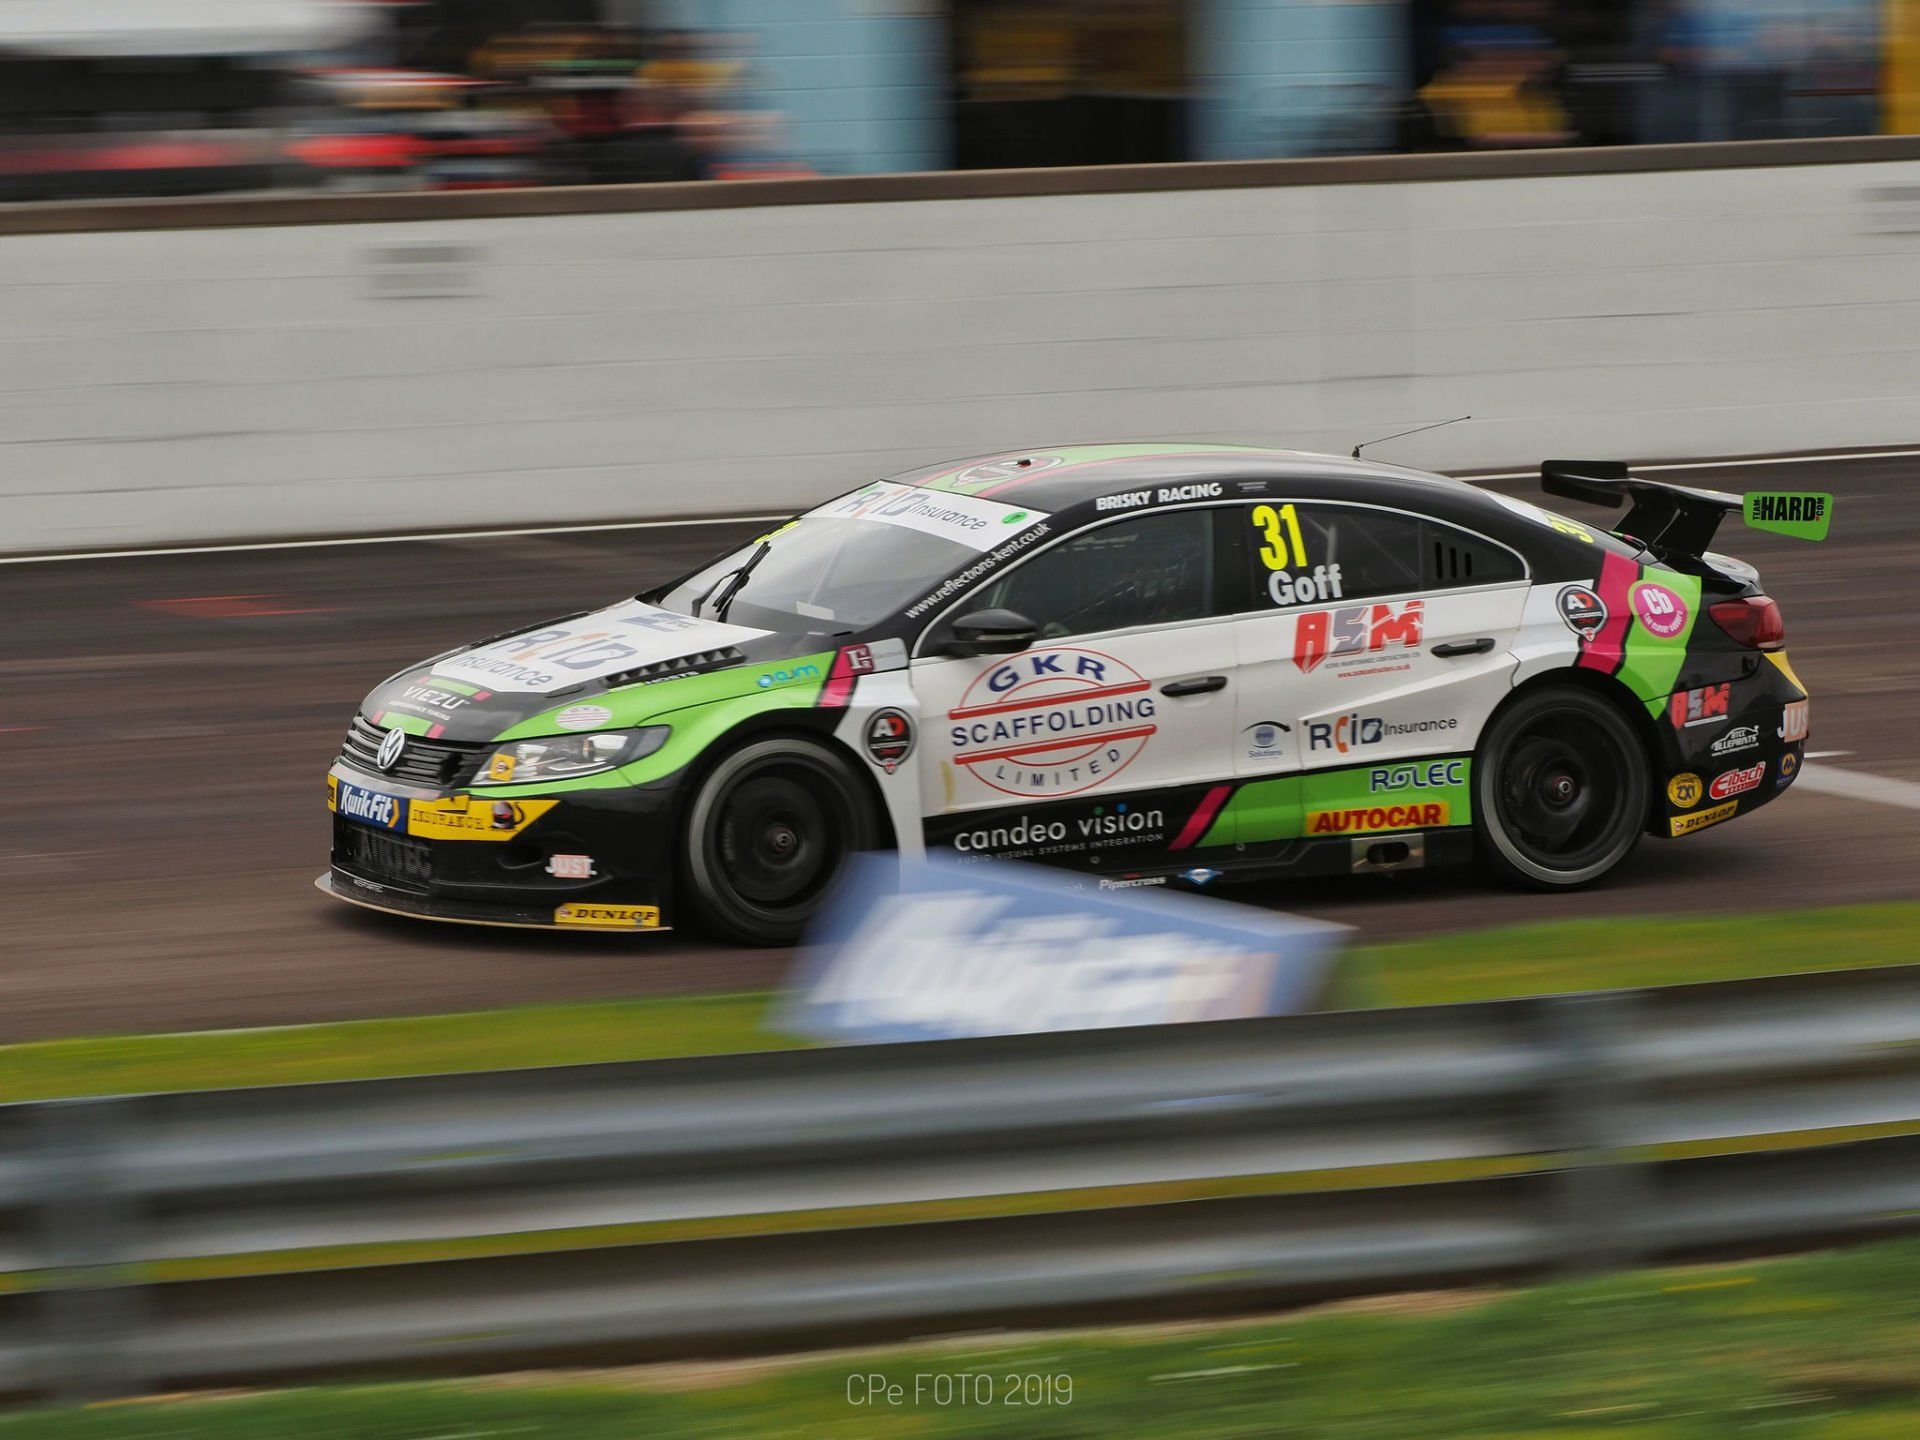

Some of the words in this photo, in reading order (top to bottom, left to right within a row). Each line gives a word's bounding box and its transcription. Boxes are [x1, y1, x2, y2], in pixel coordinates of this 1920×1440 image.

[1096, 490, 1152, 511] BRISKY
[1158, 482, 1223, 503] RACING
[1761, 496, 1817, 521] HARD
[1252, 503, 1309, 571] 31
[1268, 563, 1344, 606] Goff
[1293, 600, 1424, 675] ASM
[402, 686, 465, 710] VIEZU
[951, 698, 1156, 747] SCAFFOLDING
[995, 748, 1121, 788] LIMITED
[1370, 761, 1464, 793] ROLEC
[954, 815, 1067, 852] candeo
[1077, 803, 1164, 837] vision
[1313, 803, 1442, 833] AUTOCAR
[1686, 806, 1735, 829] DUNLOP
[1038, 842, 1086, 855] SYSTEMS
[1088, 833, 1164, 849] INTEGRATION
[1099, 876, 1167, 891] Pipercross
[575, 909, 657, 921] DUNLOP
